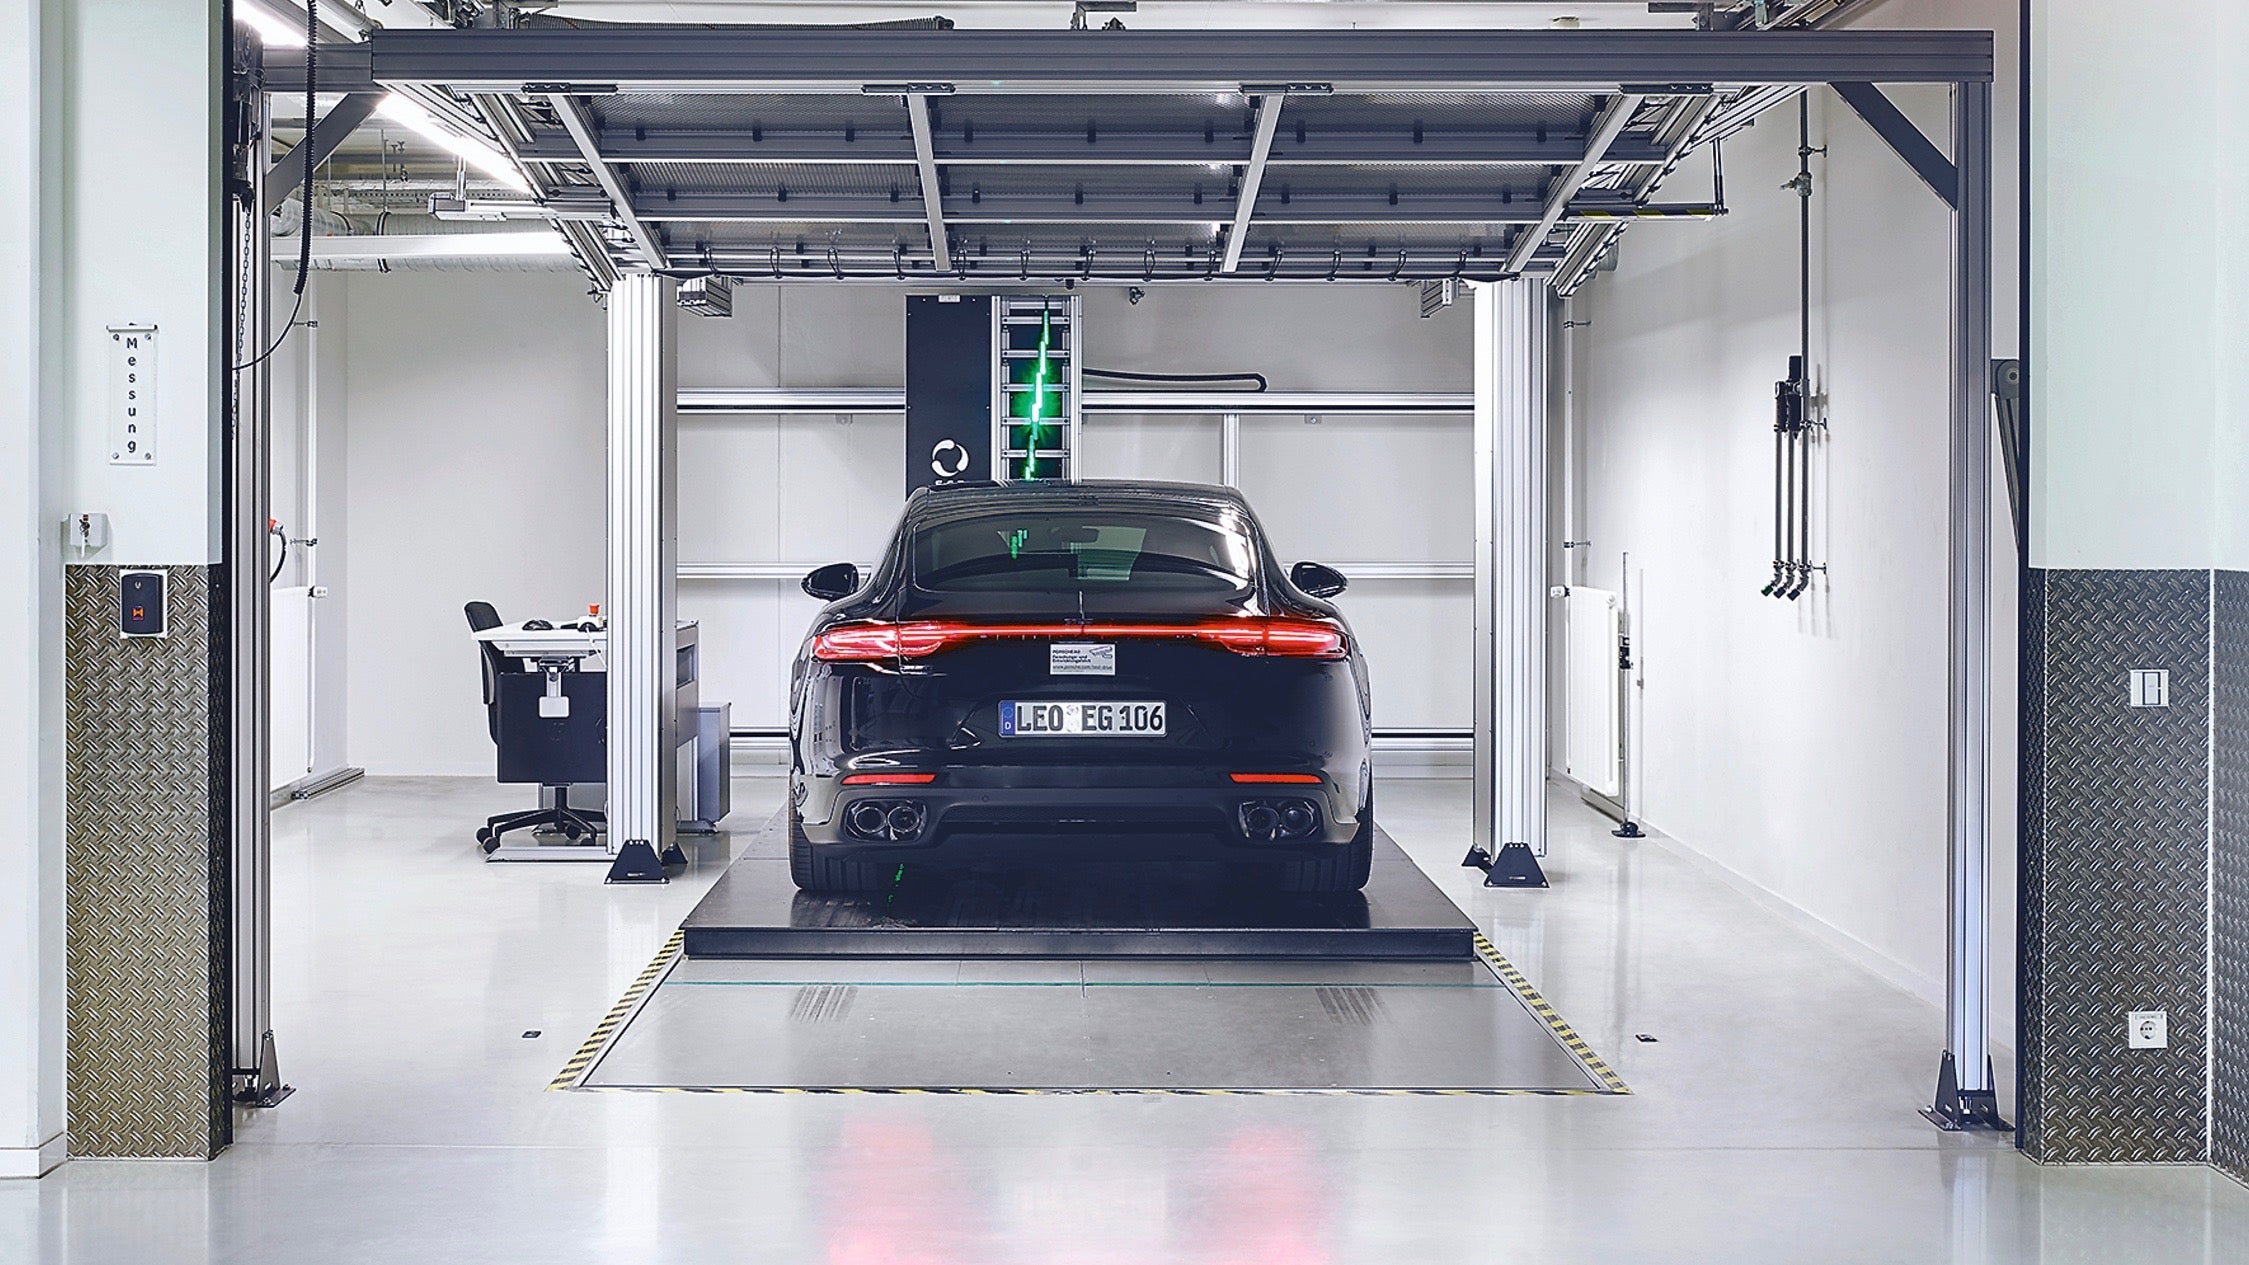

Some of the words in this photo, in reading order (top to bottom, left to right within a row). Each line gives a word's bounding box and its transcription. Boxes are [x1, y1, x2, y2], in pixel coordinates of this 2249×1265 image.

[126, 337, 138, 454] Messung
[1005, 721, 1012, 730] D
[1017, 705, 1063, 731] LEO
[1081, 705, 1113, 731] EG
[1119, 705, 1163, 731] 106
